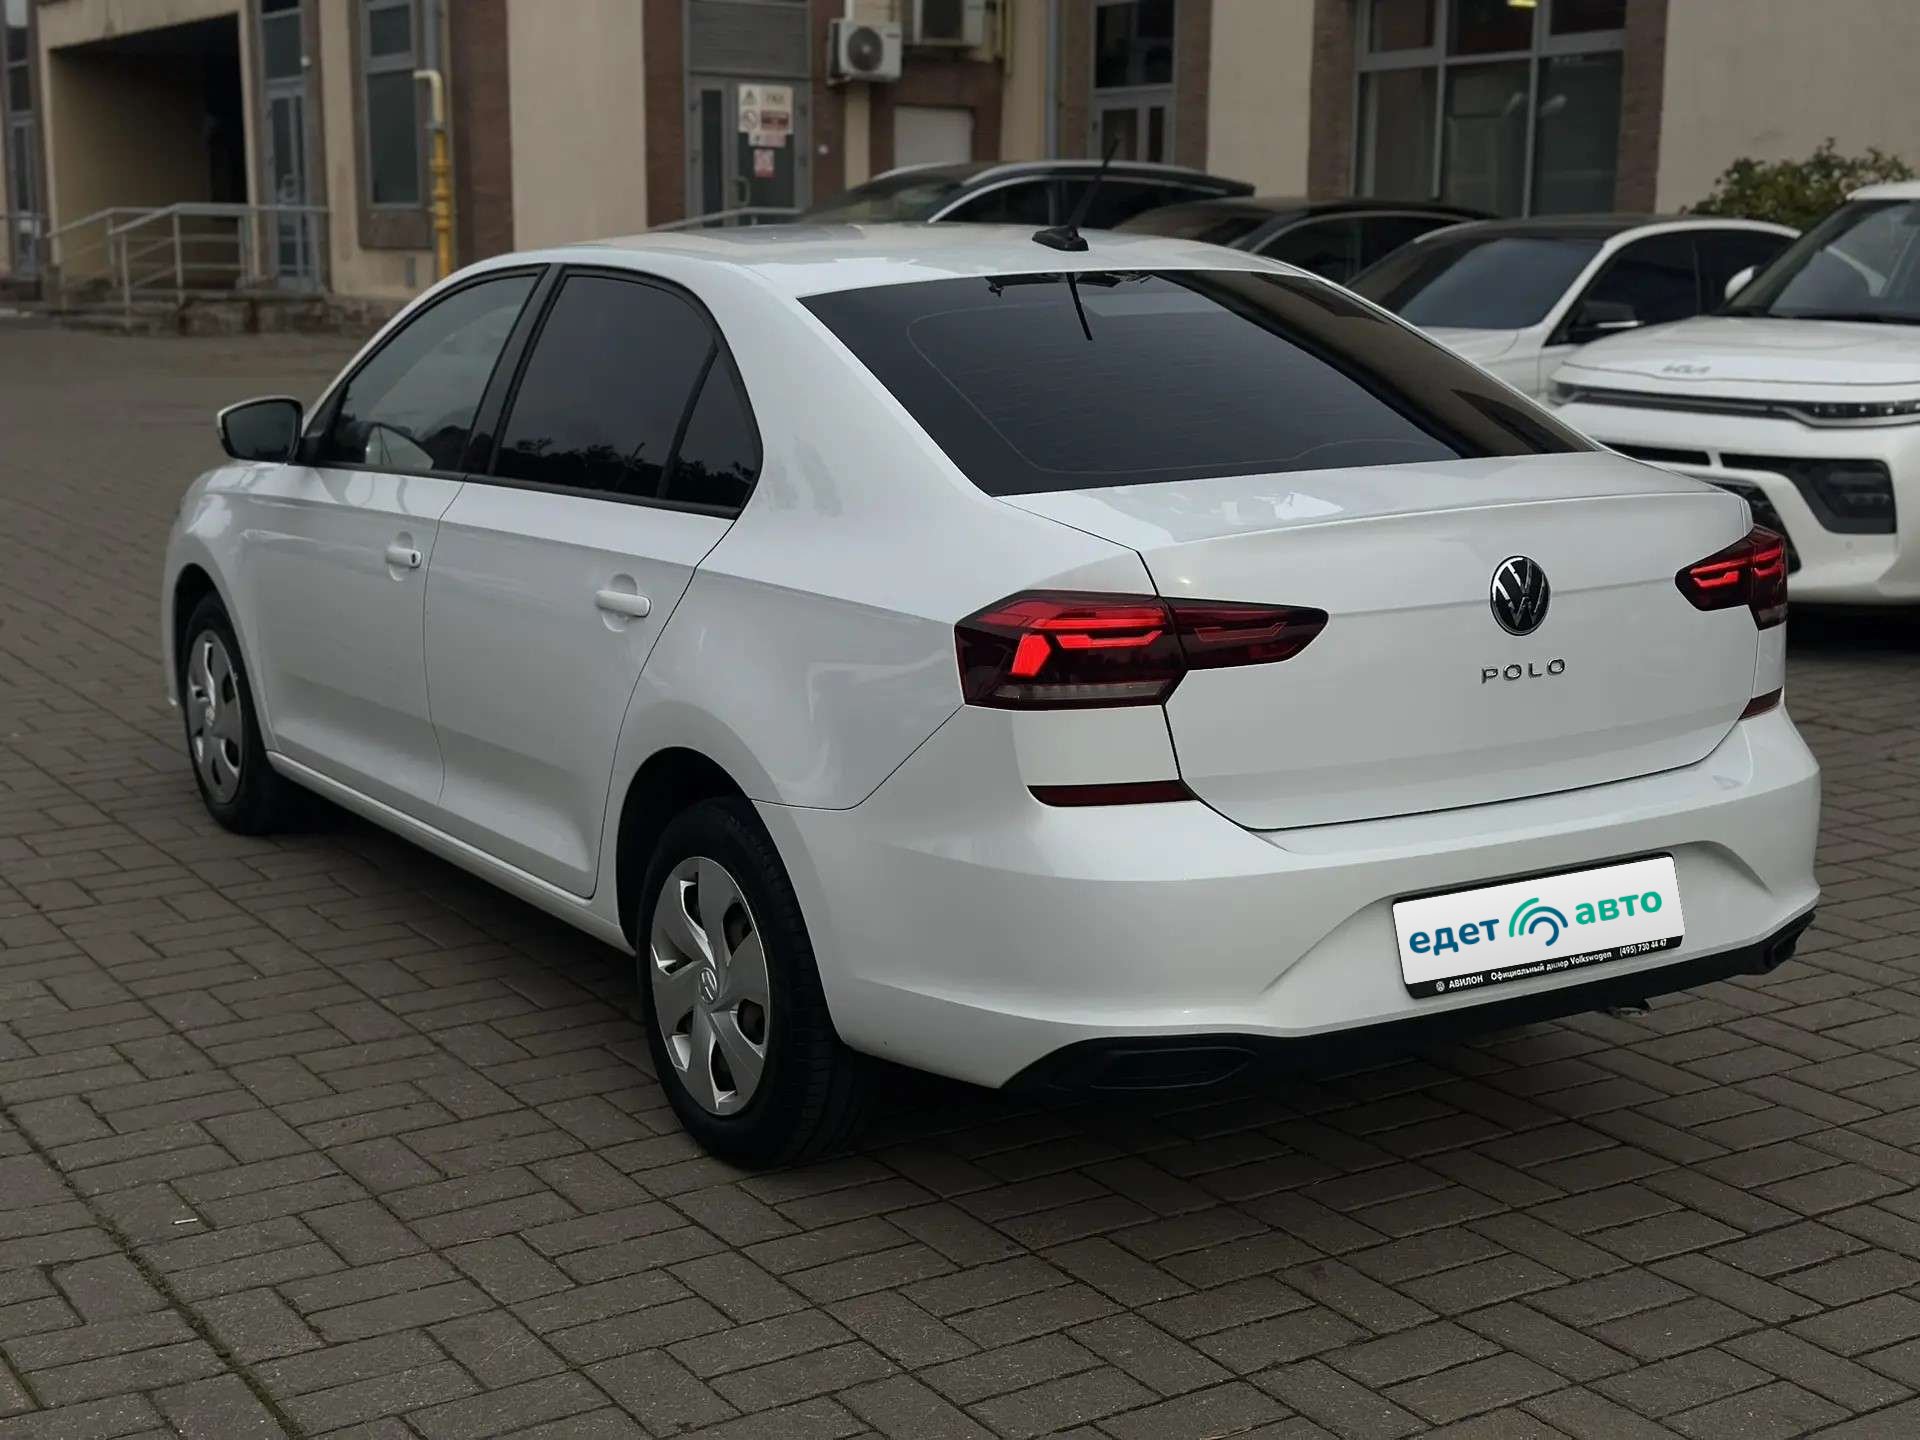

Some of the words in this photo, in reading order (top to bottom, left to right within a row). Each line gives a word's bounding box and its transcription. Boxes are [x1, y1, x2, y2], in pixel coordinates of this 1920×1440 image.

[1481, 658, 1565, 684] POLO
[1449, 974, 1483, 989] АВИЛОН
[1490, 963, 1545, 981] Официальный
[1570, 951, 1612, 964] Volkswagen
[1620, 944, 1637, 957] (495)
[1637, 942, 1649, 952] 730
